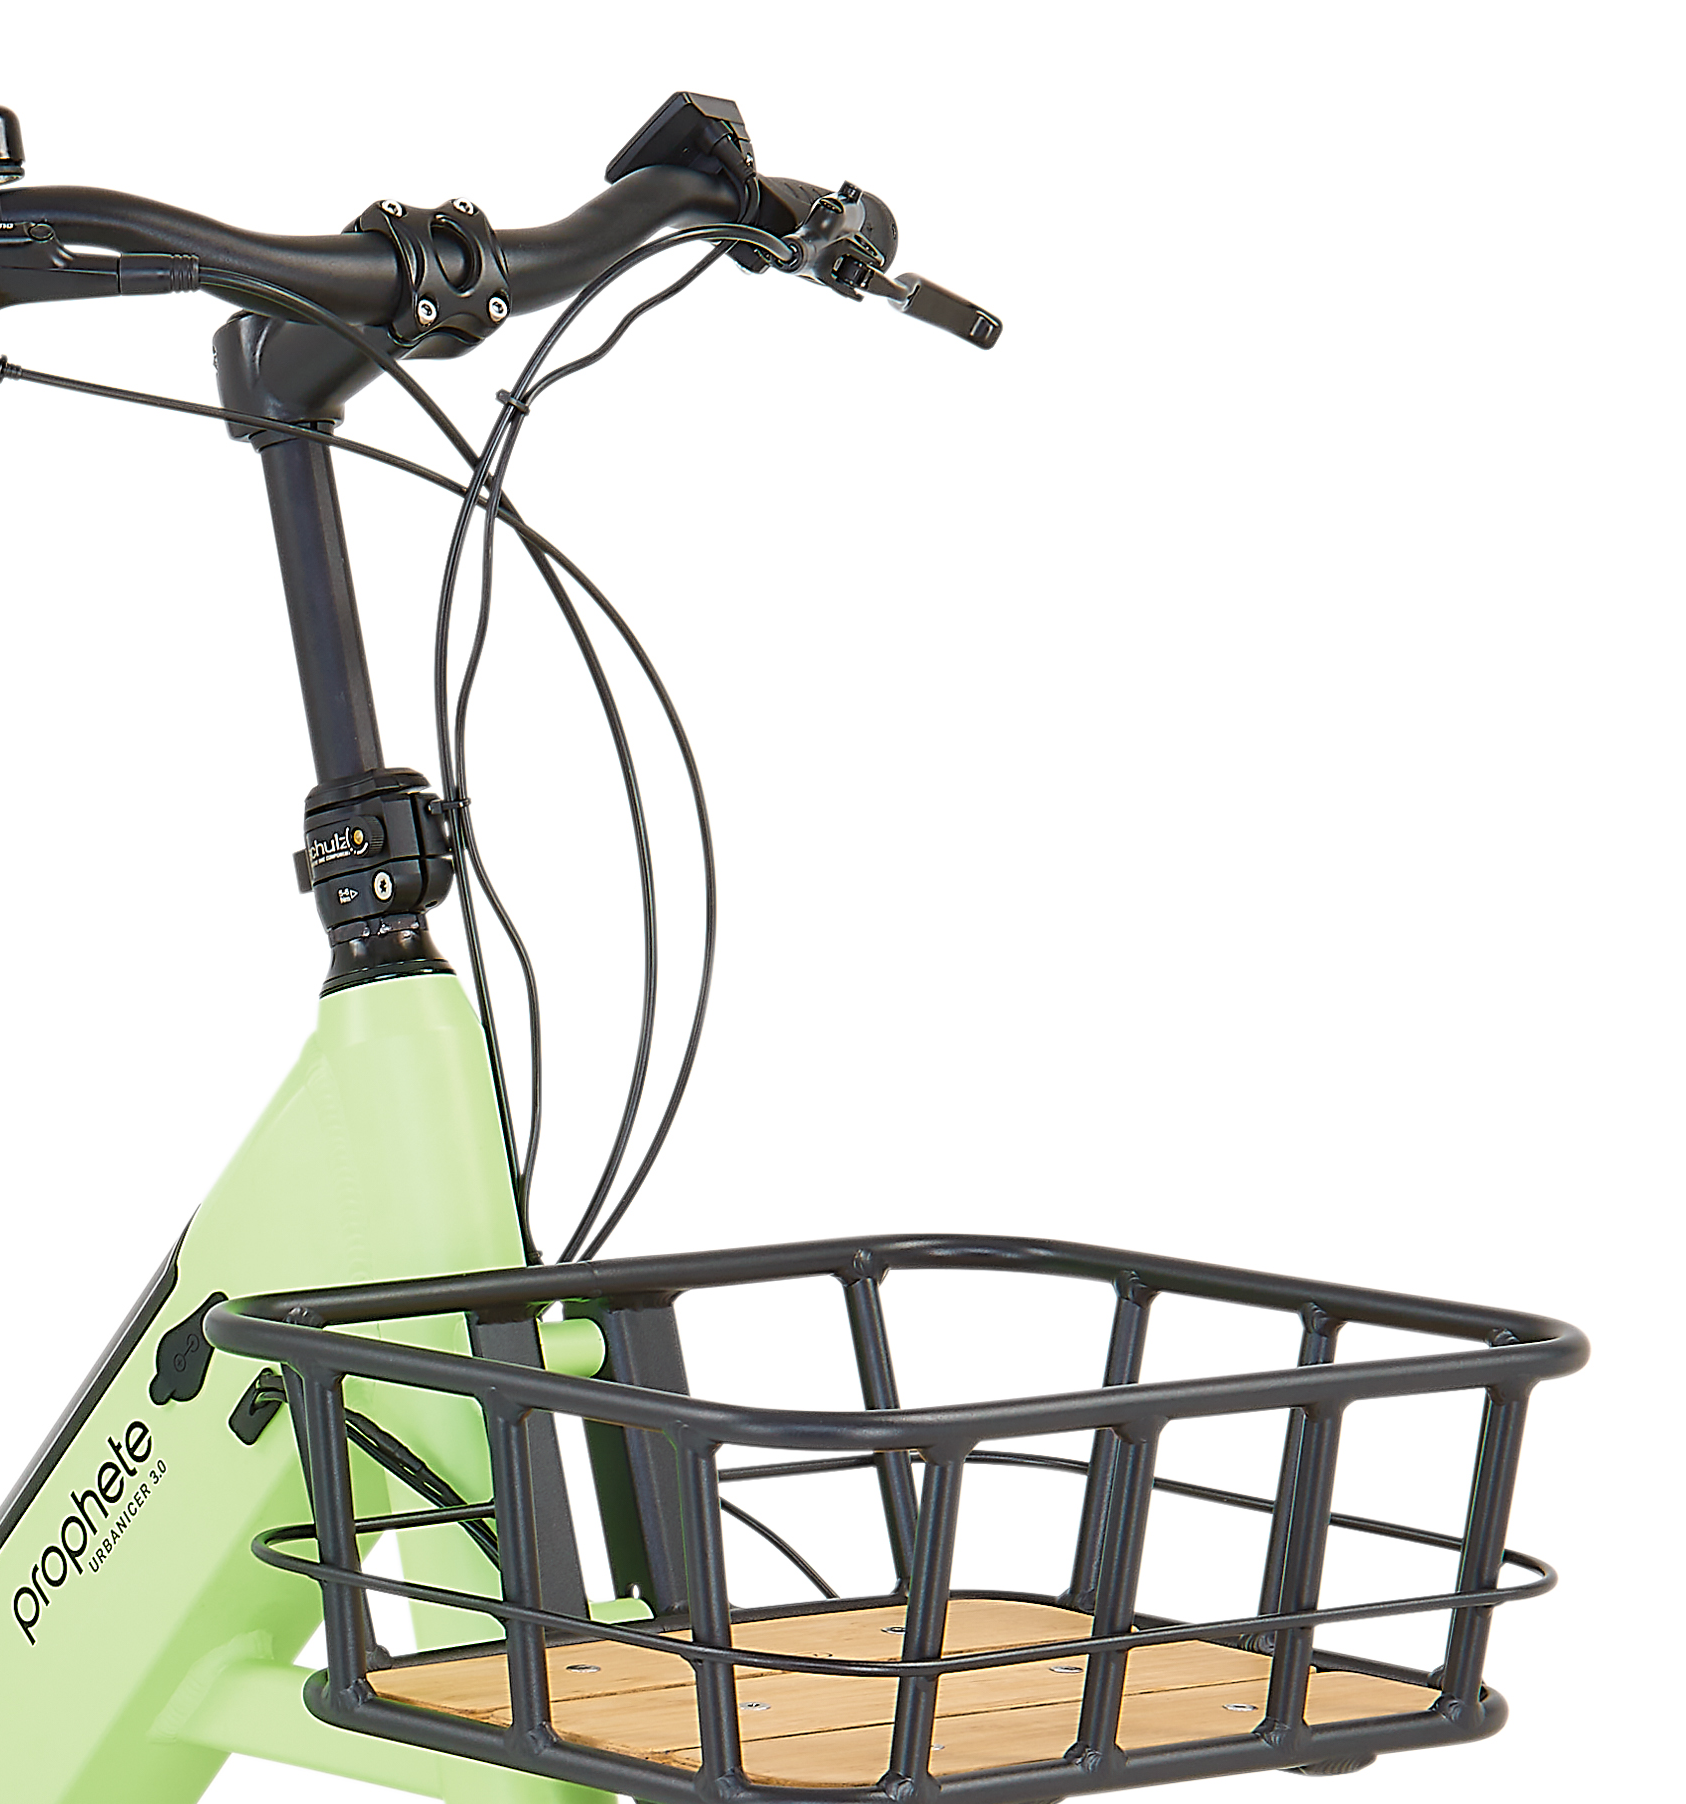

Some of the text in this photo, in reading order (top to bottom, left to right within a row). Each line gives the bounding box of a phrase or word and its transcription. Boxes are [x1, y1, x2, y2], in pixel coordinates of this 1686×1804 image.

[309, 827, 351, 859] chulz
[13, 1420, 153, 1646] prophete
[88, 1459, 167, 1573] URBANICER 3.0
